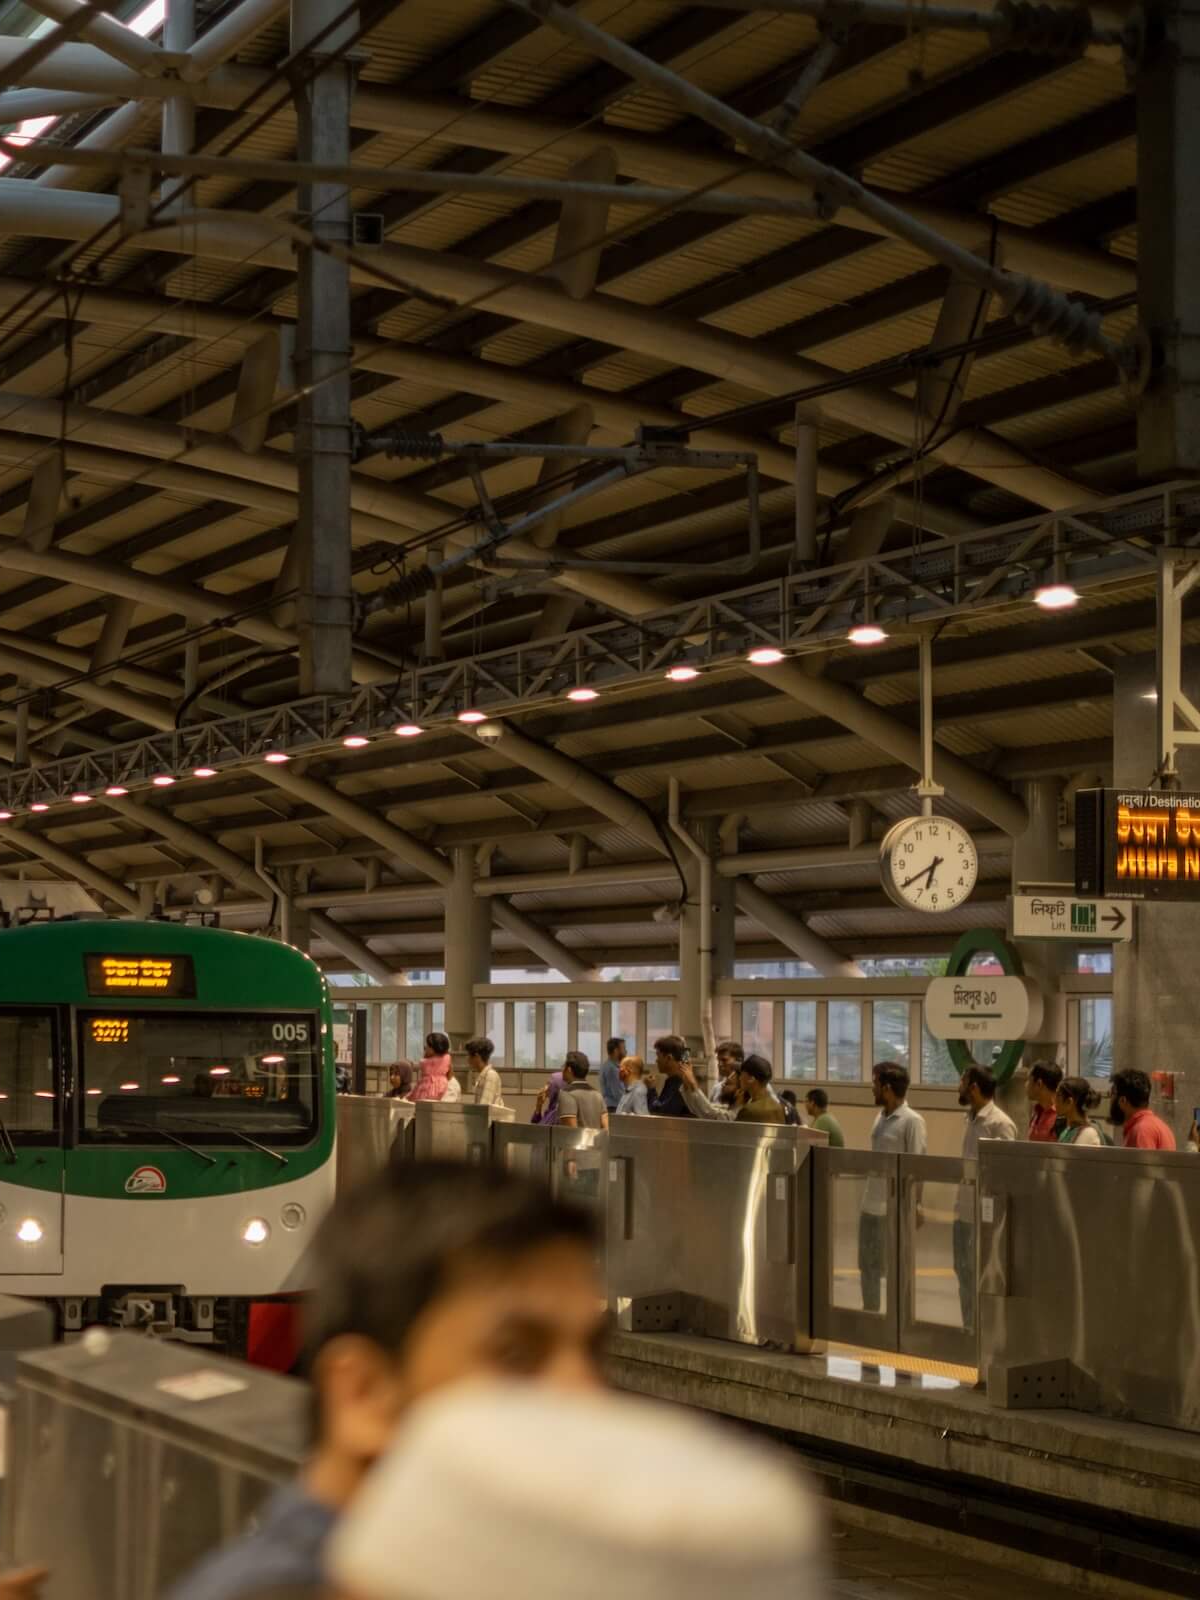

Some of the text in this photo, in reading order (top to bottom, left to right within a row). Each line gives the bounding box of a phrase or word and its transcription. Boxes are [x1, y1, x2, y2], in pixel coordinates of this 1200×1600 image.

[928, 825, 939, 836] 12
[915, 831, 923, 841] 11
[947, 831, 951, 841] 1
[903, 843, 914, 853] 10
[957, 843, 965, 853] 2
[898, 859, 906, 870] 9
[962, 859, 969, 870] 3
[957, 876, 964, 886] 4
[915, 888, 924, 899] 7
[947, 888, 954, 898] 5
[931, 893, 938, 904] 6
[271, 1023, 308, 1041] 005
